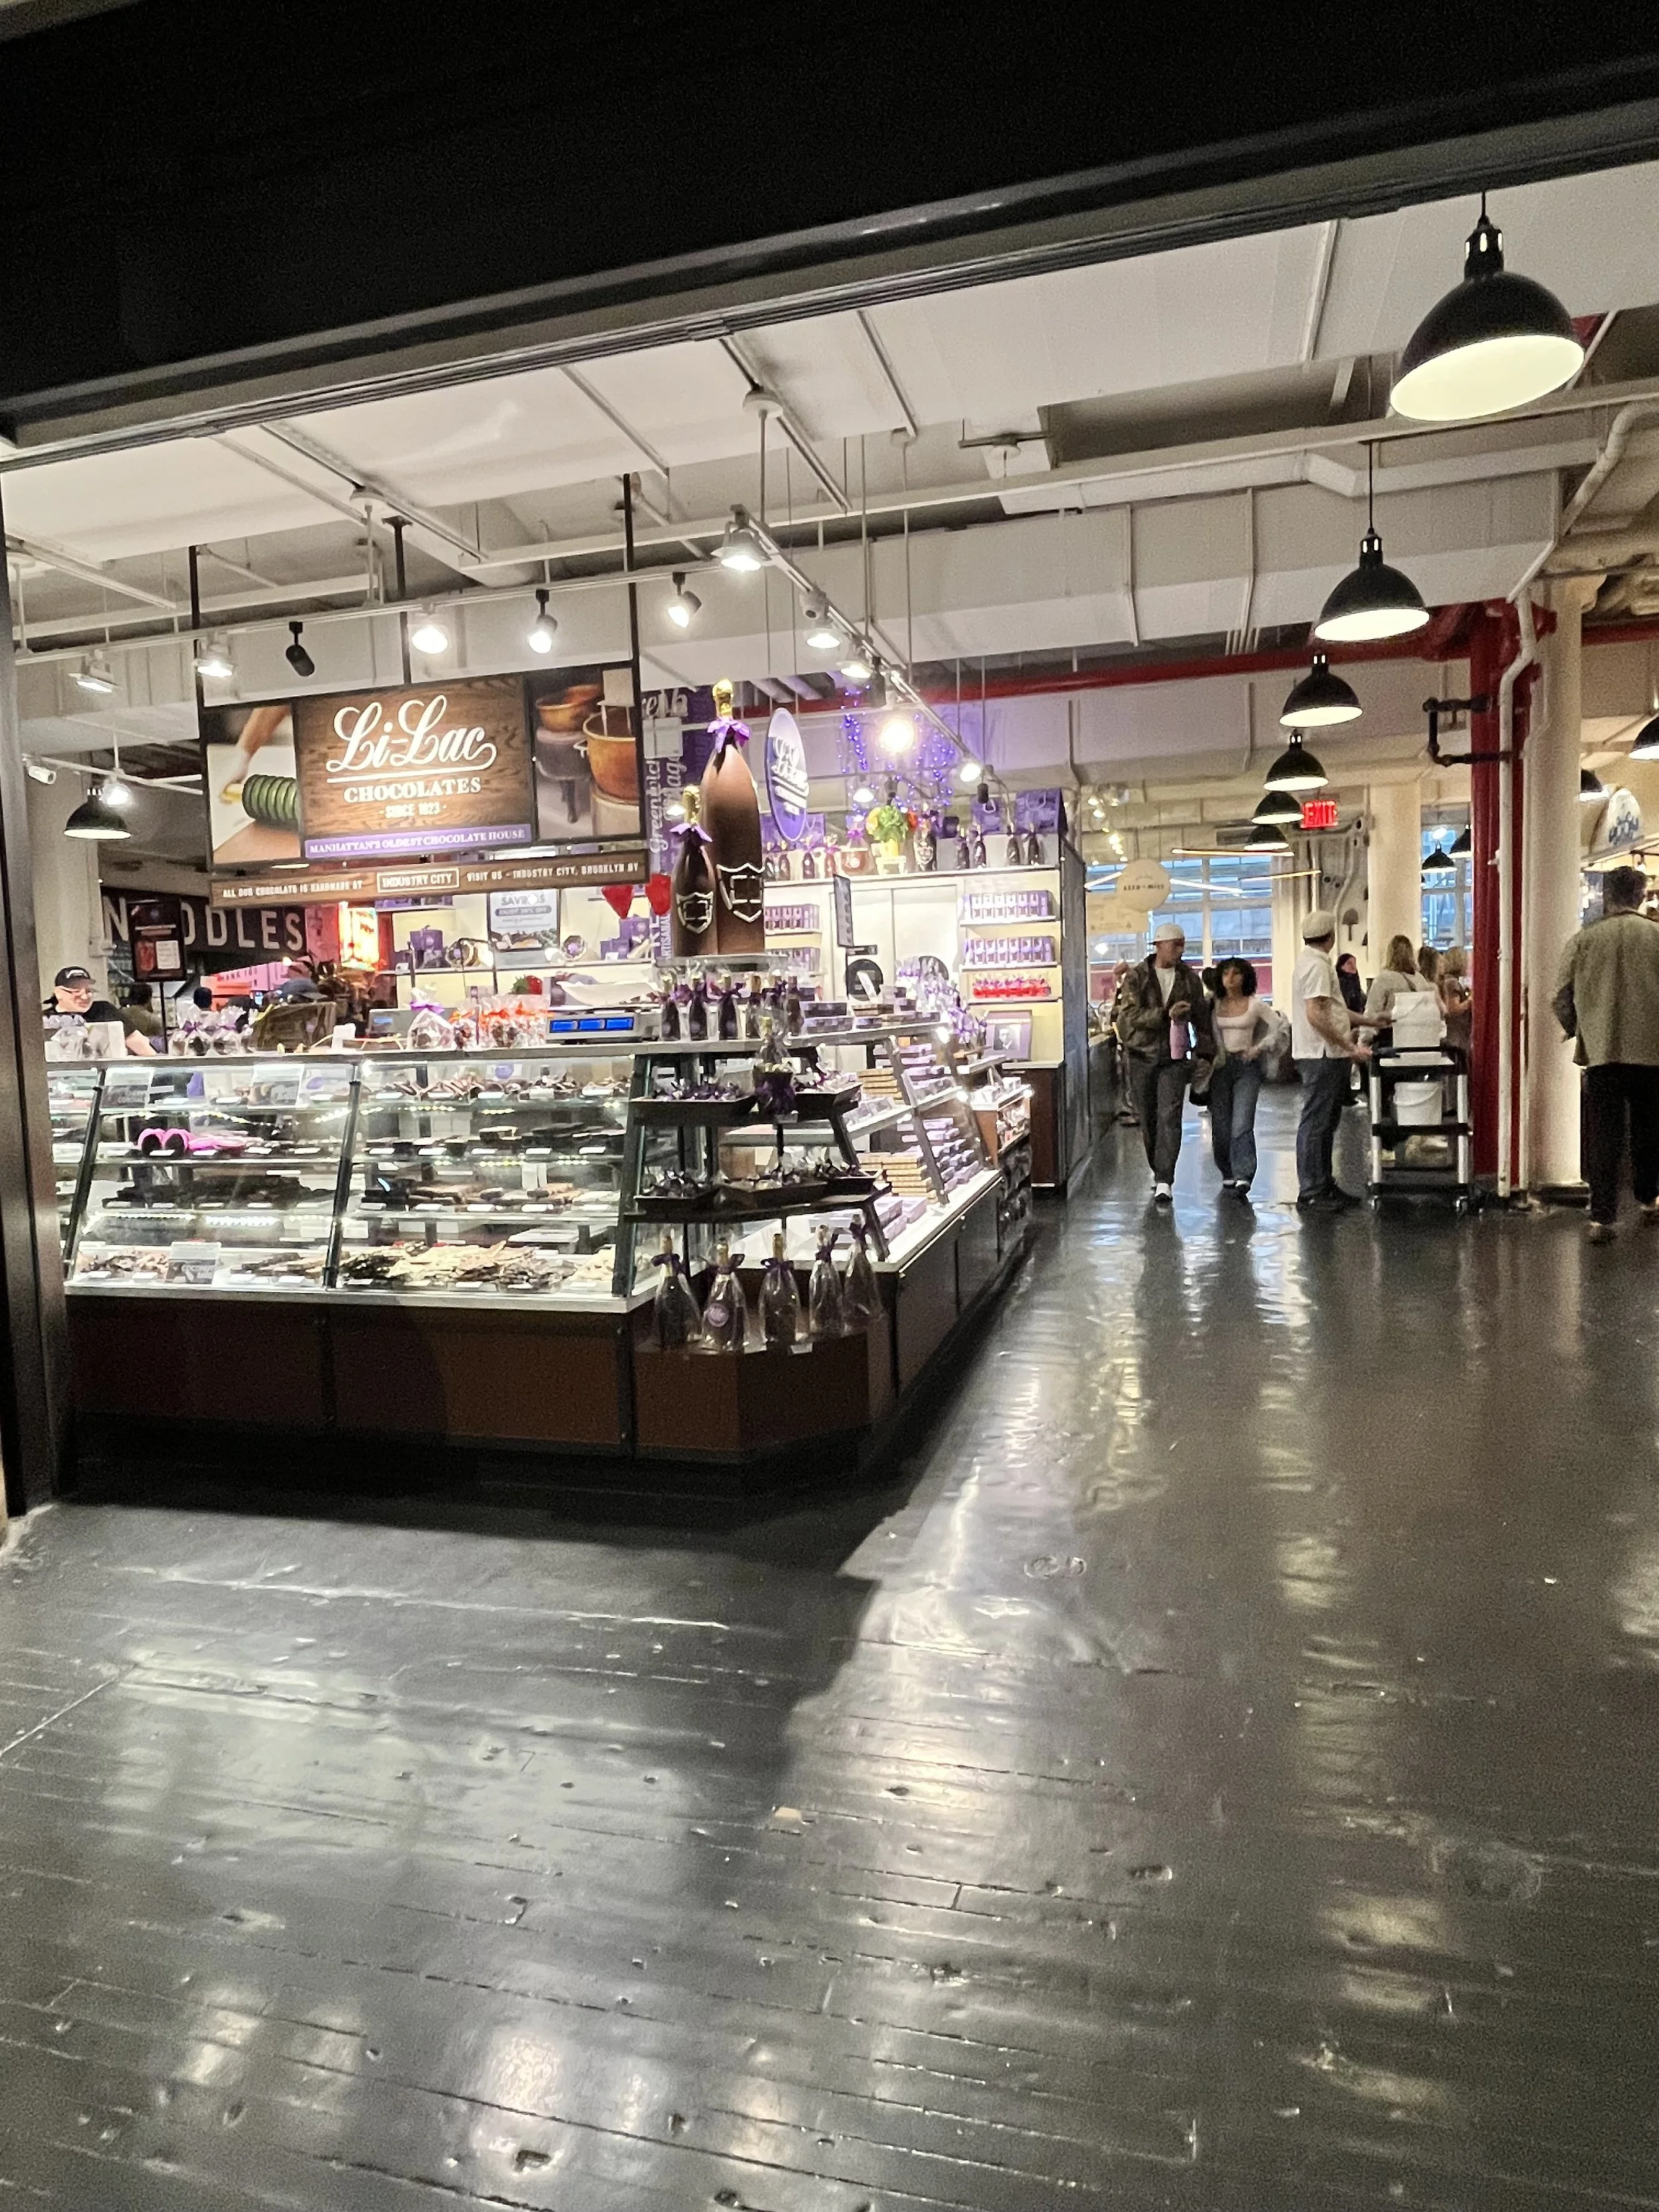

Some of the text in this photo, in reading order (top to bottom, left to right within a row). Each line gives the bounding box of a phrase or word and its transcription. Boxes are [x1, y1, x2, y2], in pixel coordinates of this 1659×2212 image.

[326, 695, 497, 773] Li-Lac
[344, 777, 481, 803] CHOCOLATES
[386, 804, 414, 818] SINCE
[1305, 800, 1335, 825] EXIT
[310, 829, 525, 853] MANHATTAN'S OLDEST CHOCOLATE HOUSE
[382, 875, 428, 888] INDUSTRY
[430, 873, 452, 885] CITY
[467, 871, 488, 882] VISIT
[491, 871, 502, 880] US
[513, 867, 553, 879] INDUSTRY
[581, 863, 624, 875] BROOKLYN
[102, 896, 303, 951] NODLES
